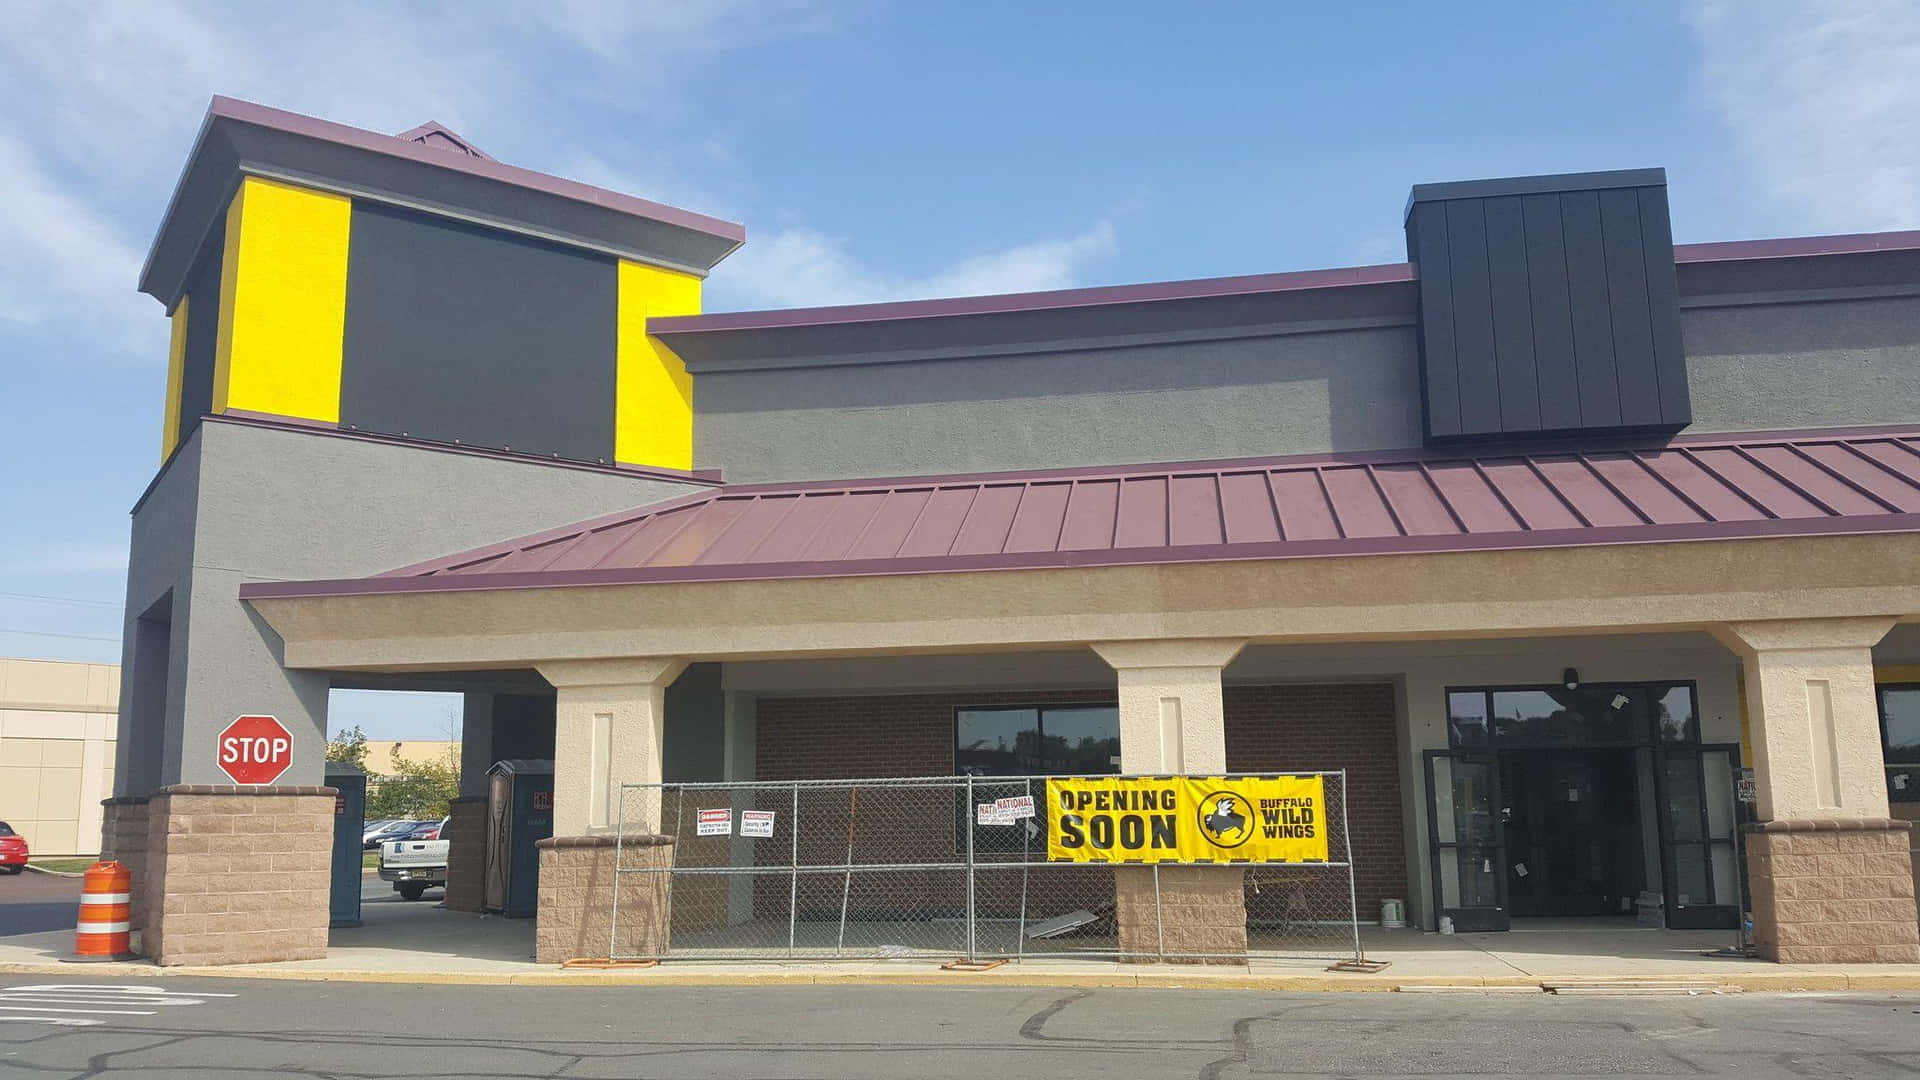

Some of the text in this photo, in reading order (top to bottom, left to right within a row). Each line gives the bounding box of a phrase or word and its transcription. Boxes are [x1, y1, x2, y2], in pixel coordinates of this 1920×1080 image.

[223, 737, 288, 763] STOP
[997, 797, 1033, 809] NATIONAL
[1060, 789, 1176, 811] OPENING
[1259, 797, 1313, 809] BUFFALO
[1261, 807, 1314, 825] WILD
[1060, 814, 1177, 849] SOON
[1262, 825, 1315, 839] WINGS
